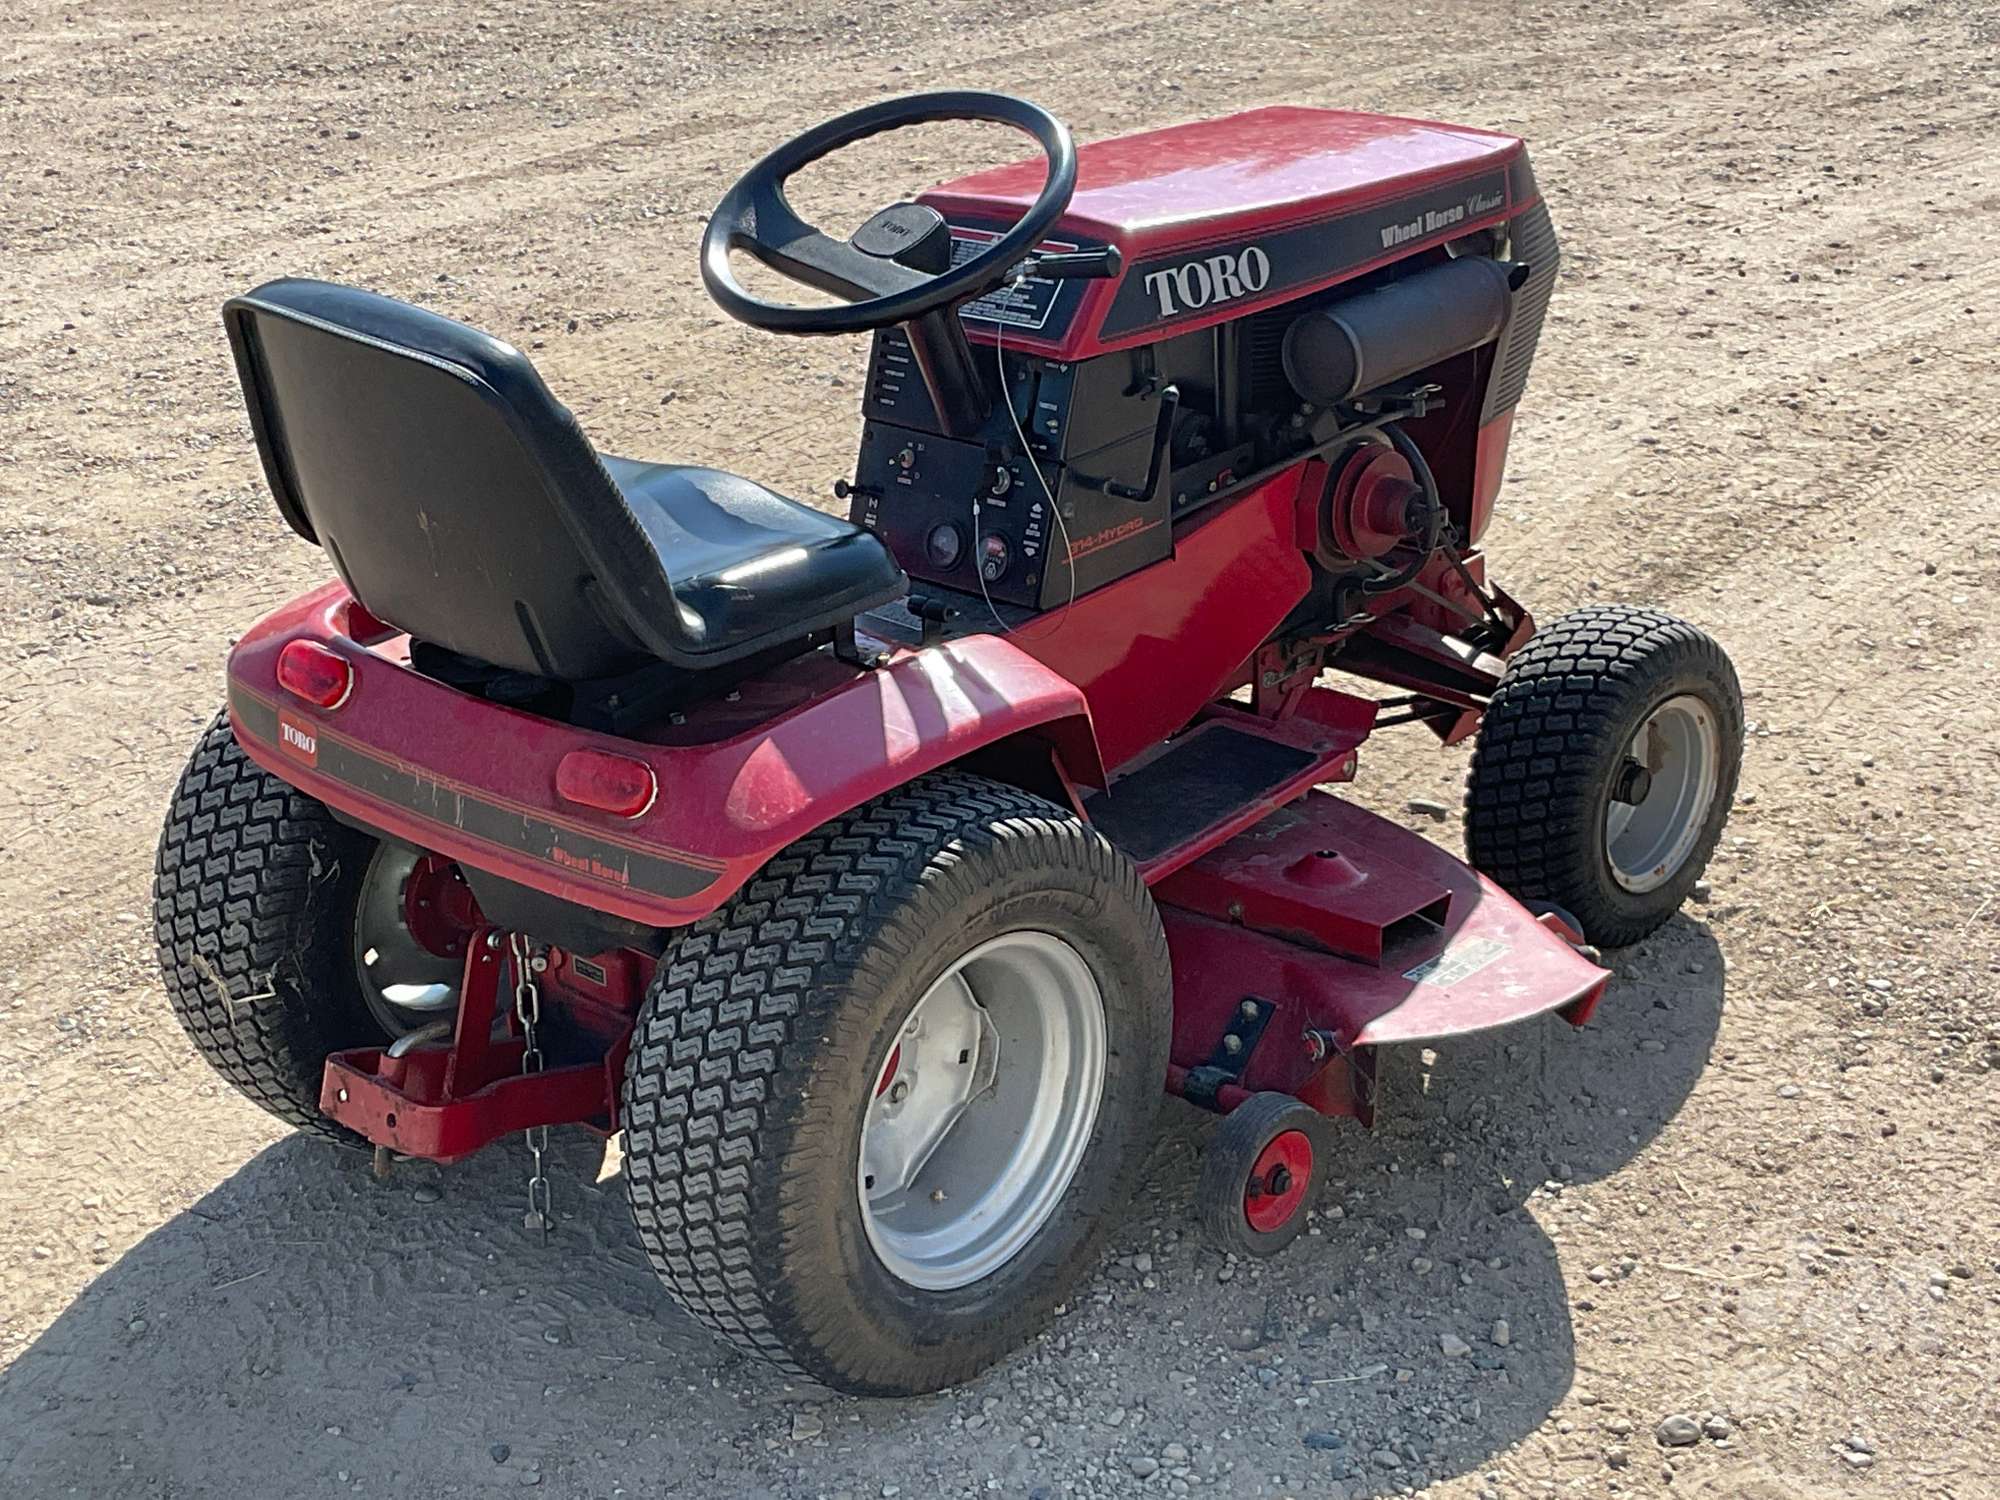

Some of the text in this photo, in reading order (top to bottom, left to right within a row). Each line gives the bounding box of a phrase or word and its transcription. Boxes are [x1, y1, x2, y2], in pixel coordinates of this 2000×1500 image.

[1381, 215, 1423, 249] Wheel
[1425, 205, 1464, 233] Horse
[1144, 246, 1270, 316] TORO
[281, 722, 317, 754] TORO
